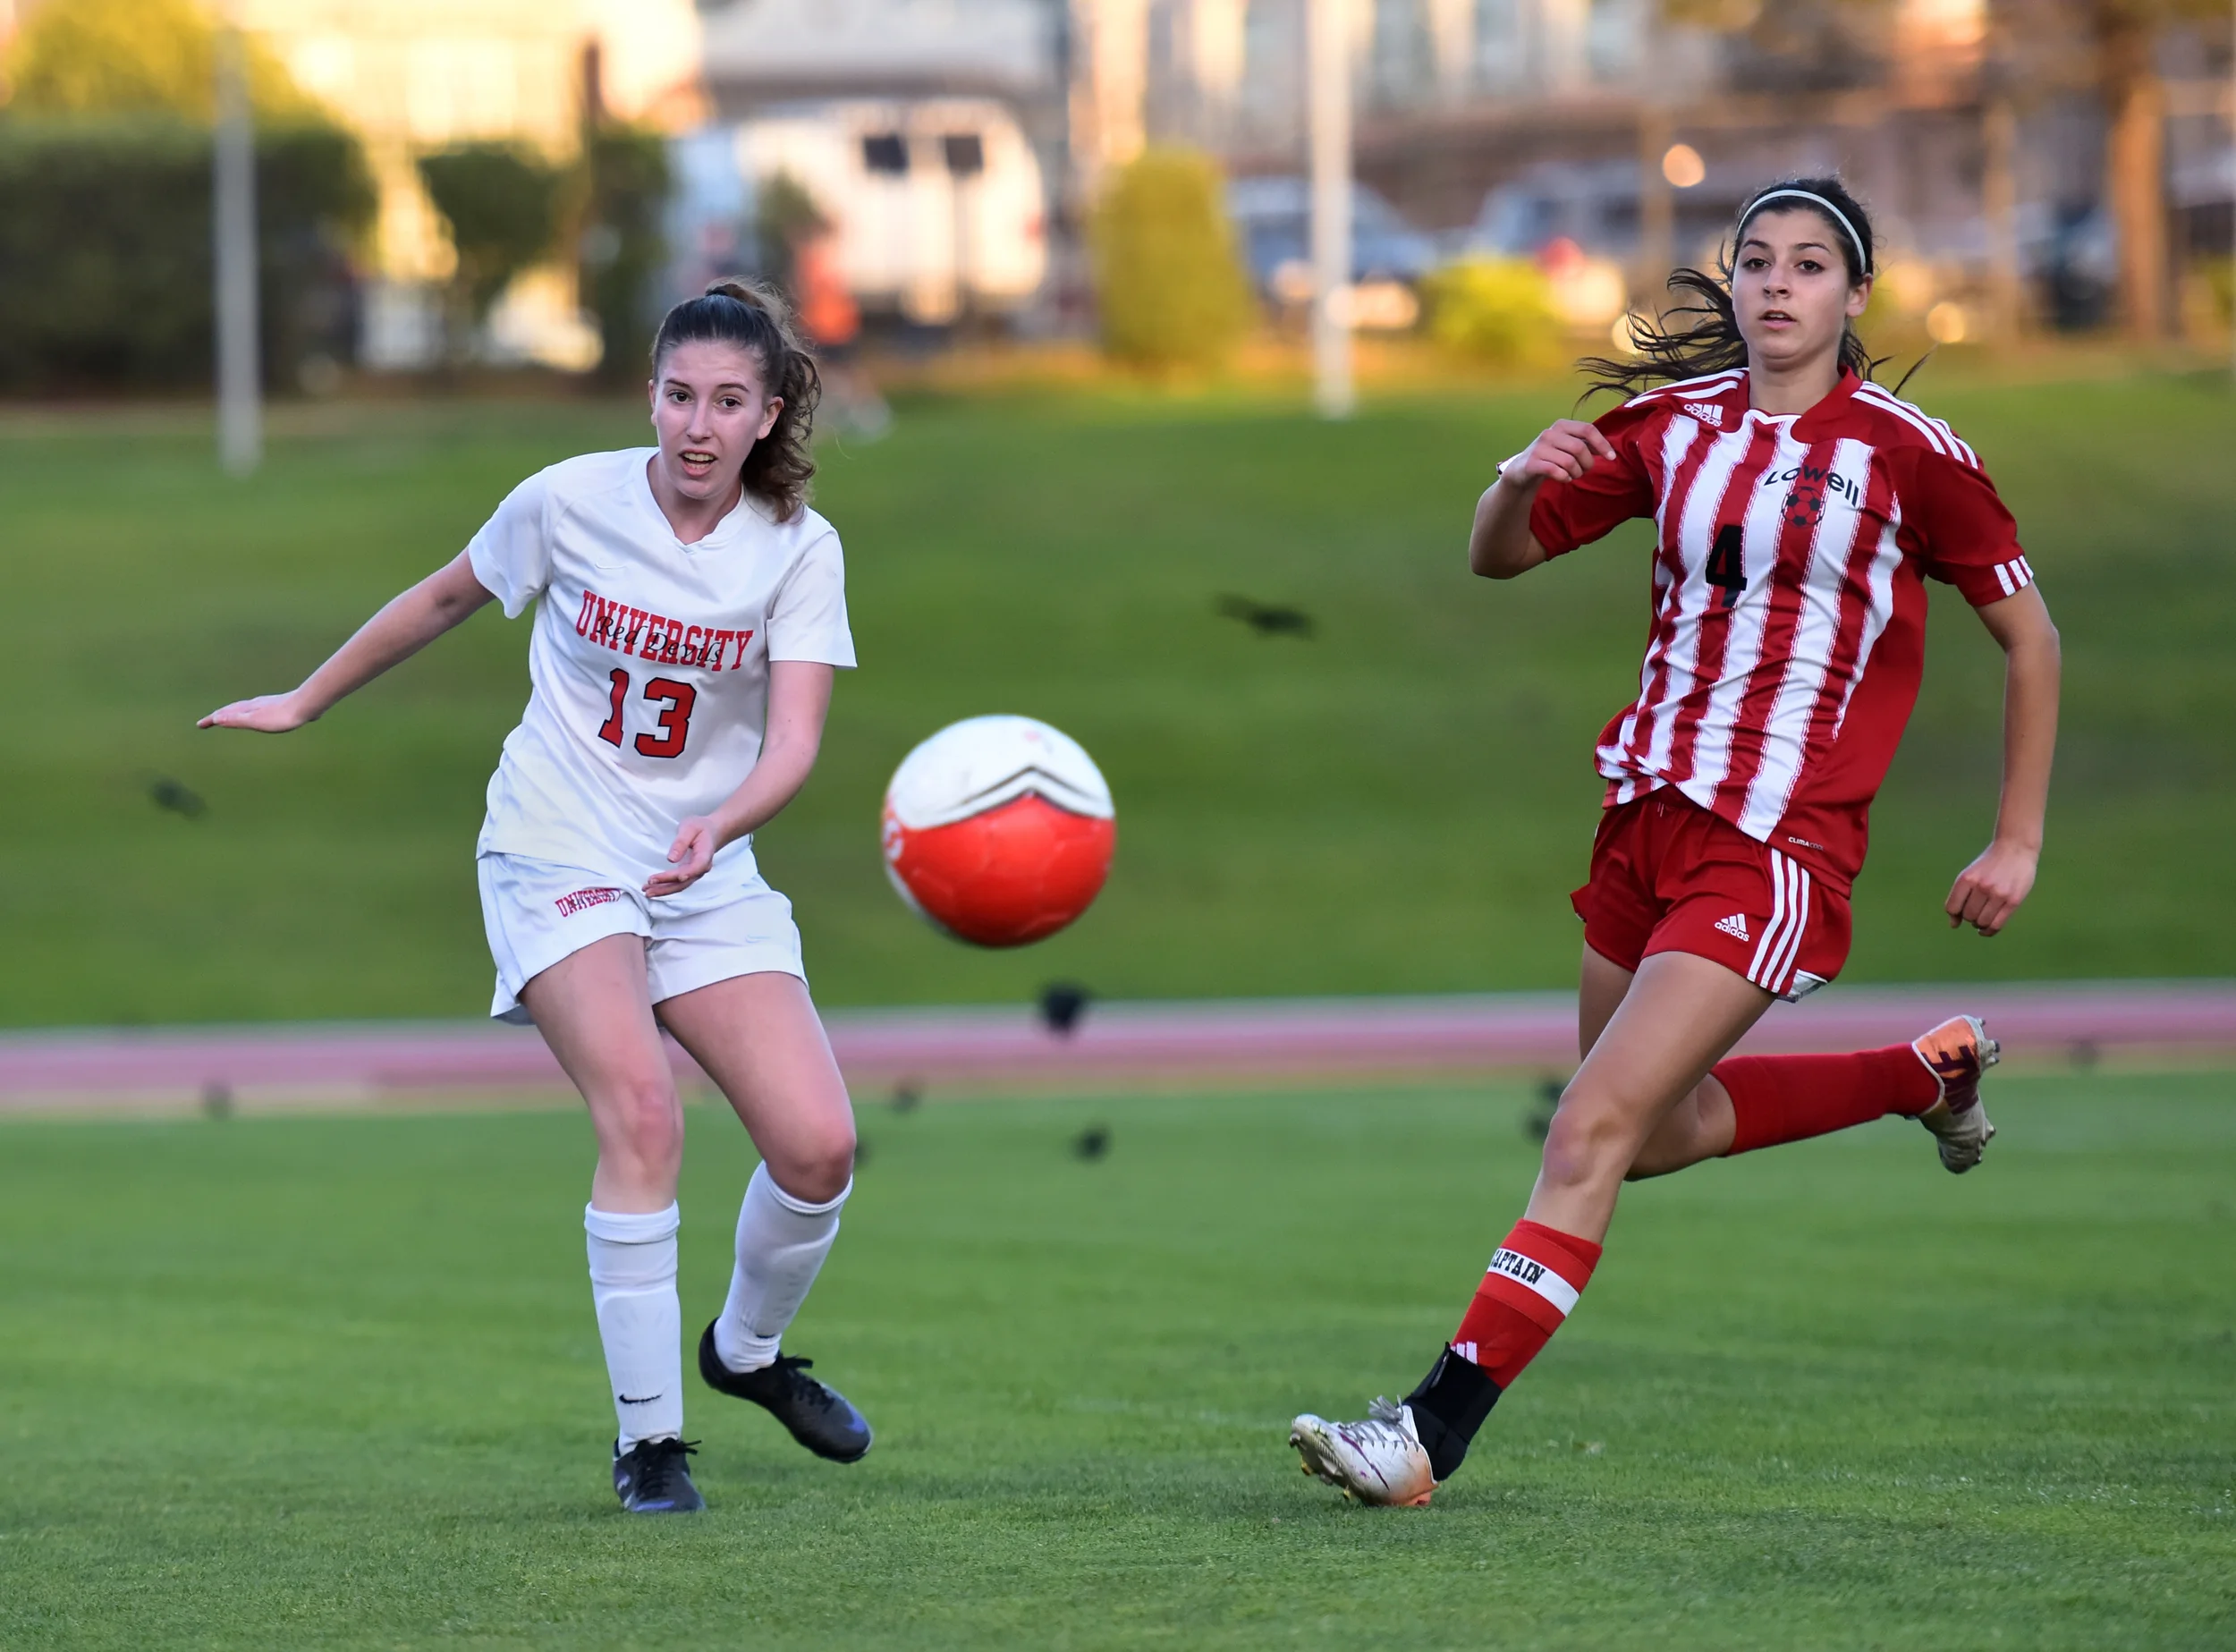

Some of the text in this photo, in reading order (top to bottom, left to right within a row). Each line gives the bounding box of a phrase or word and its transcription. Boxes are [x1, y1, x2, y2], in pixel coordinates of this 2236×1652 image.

[1683, 402, 1723, 428] adidas
[1763, 465, 1859, 506] Lowell
[1705, 524, 1748, 608] 4
[575, 589, 754, 672] UNIVERSITY
[597, 615, 723, 663] Red Devils
[597, 667, 697, 758] 13
[1714, 920, 1750, 942] adidas
[1491, 1250, 1546, 1285] APTAIN
